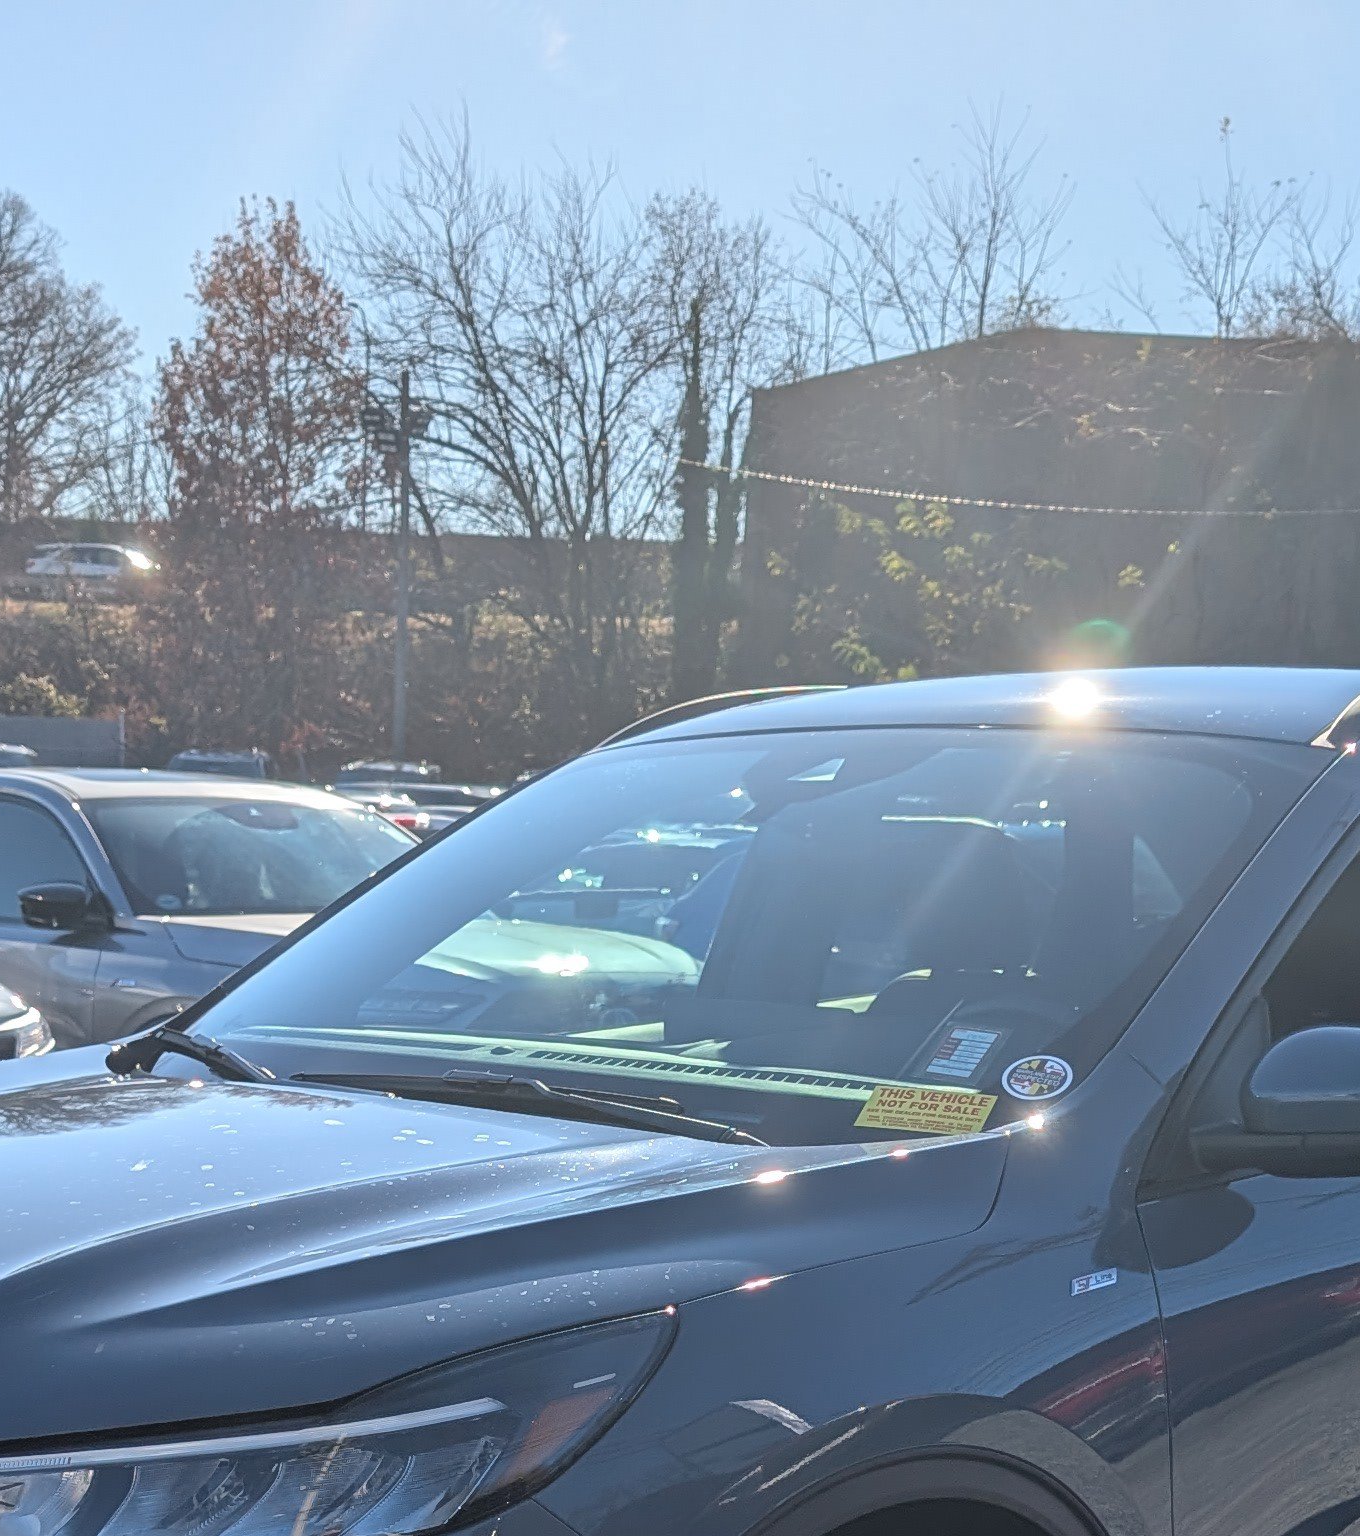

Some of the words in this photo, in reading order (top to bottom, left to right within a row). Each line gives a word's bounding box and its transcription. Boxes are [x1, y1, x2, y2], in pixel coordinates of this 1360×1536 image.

[880, 1087, 916, 1100] THIS
[920, 1090, 992, 1107] VEHICLE
[876, 1099, 907, 1109] NOT
[909, 1101, 940, 1112] FOR
[942, 1104, 982, 1116] SALE
